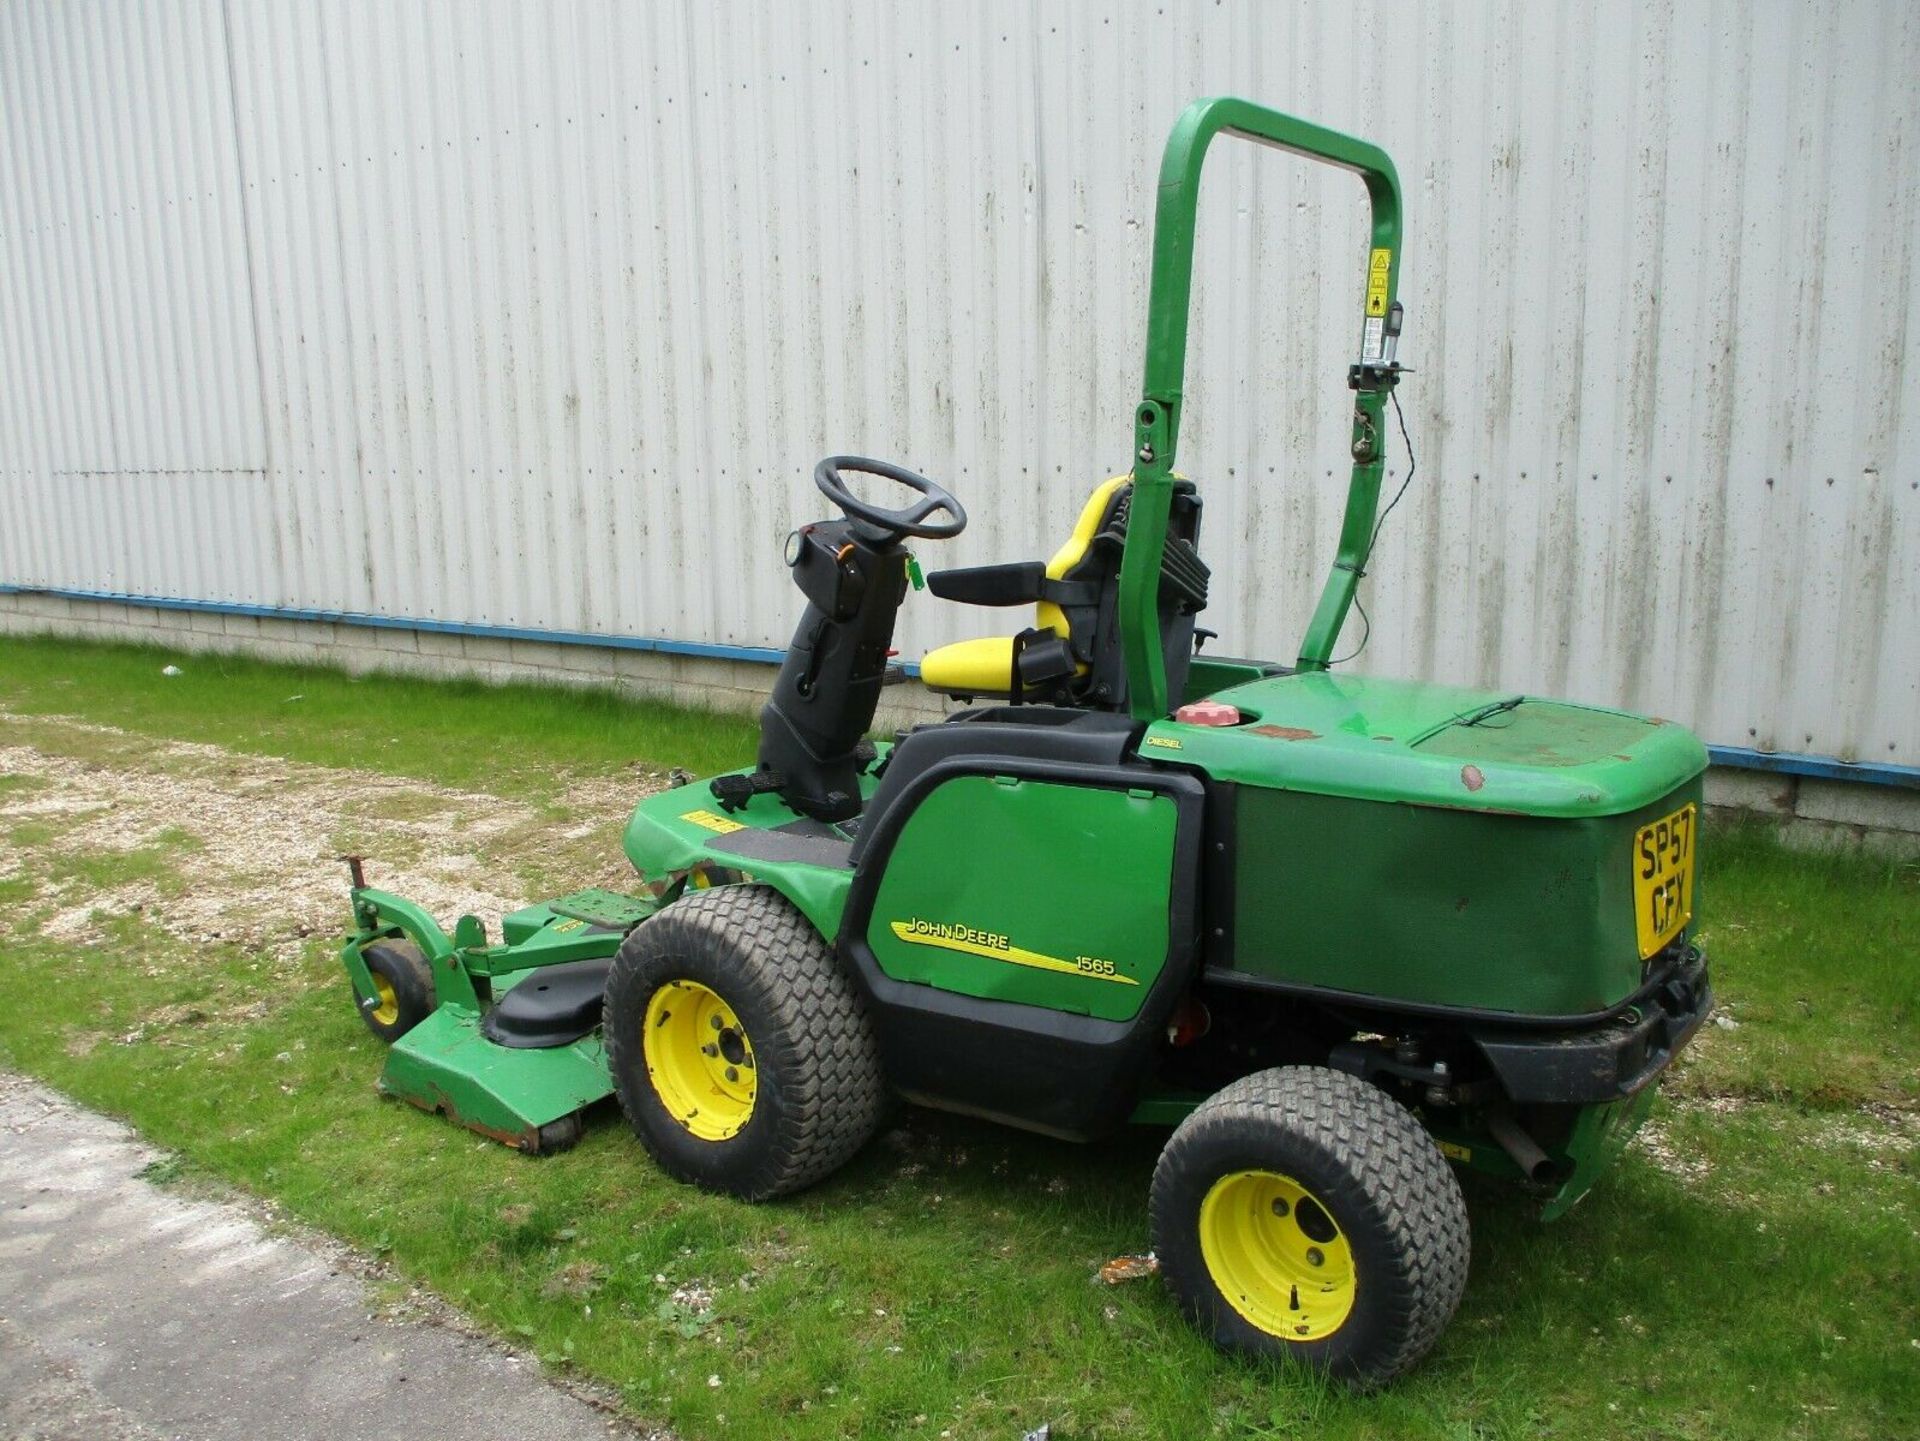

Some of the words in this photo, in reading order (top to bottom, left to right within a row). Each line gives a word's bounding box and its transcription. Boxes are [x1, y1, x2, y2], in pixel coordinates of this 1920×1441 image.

[1146, 736, 1182, 749] DIESEL
[1641, 809, 1690, 880] SP57
[1652, 868, 1685, 934] CFX
[906, 917, 953, 939] JOHN
[955, 923, 1009, 950] DEERE
[1075, 955, 1115, 975] 1565
